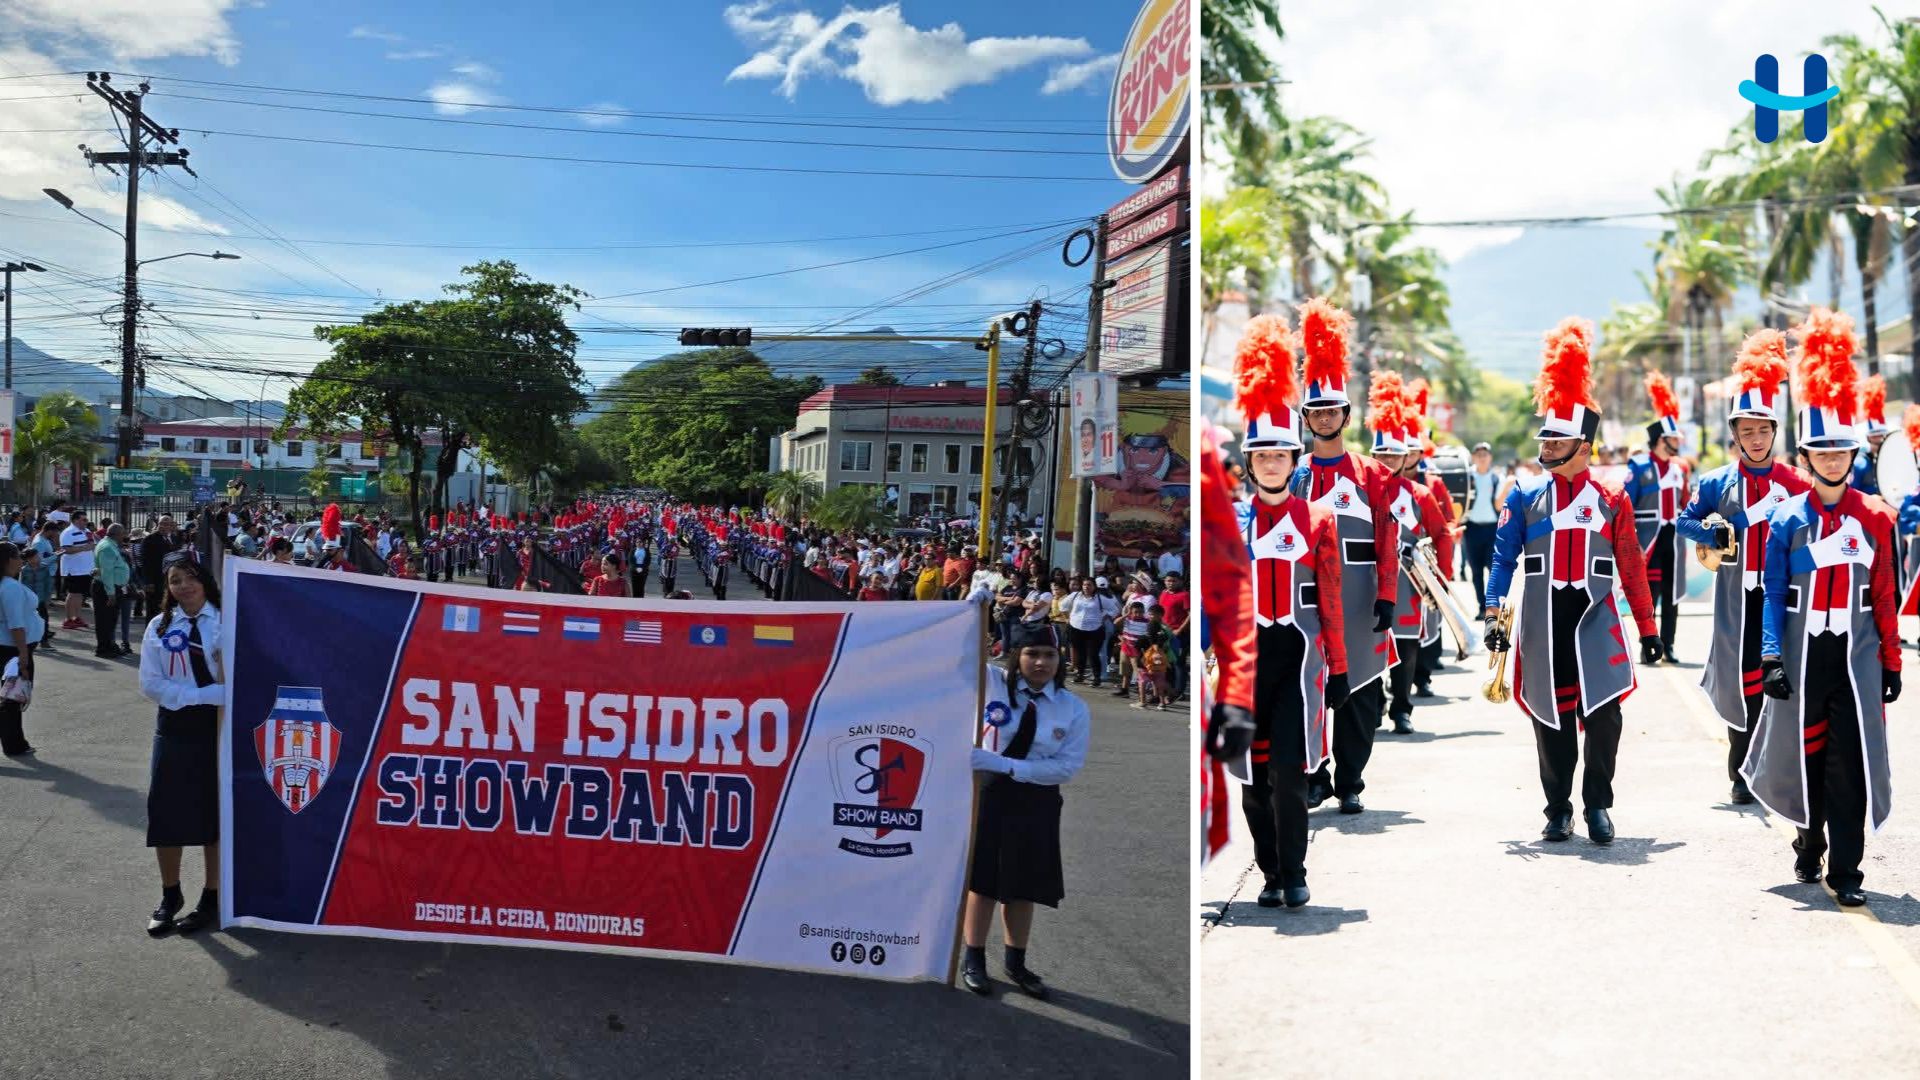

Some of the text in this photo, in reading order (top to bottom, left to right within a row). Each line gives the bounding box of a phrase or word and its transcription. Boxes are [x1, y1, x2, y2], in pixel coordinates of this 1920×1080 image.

[1101, 431, 1113, 457] 11
[112, 472, 134, 480] Hotel
[401, 677, 790, 767] SAN ISIDRO
[848, 724, 917, 739] SAN ISIDRO
[376, 752, 755, 850] SHOWBAND
[837, 806, 918, 827] SHOW BAND
[415, 902, 645, 937] DESDE LA CEIBA, HONDURAS
[799, 923, 921, 946] @sanisidroshowband
